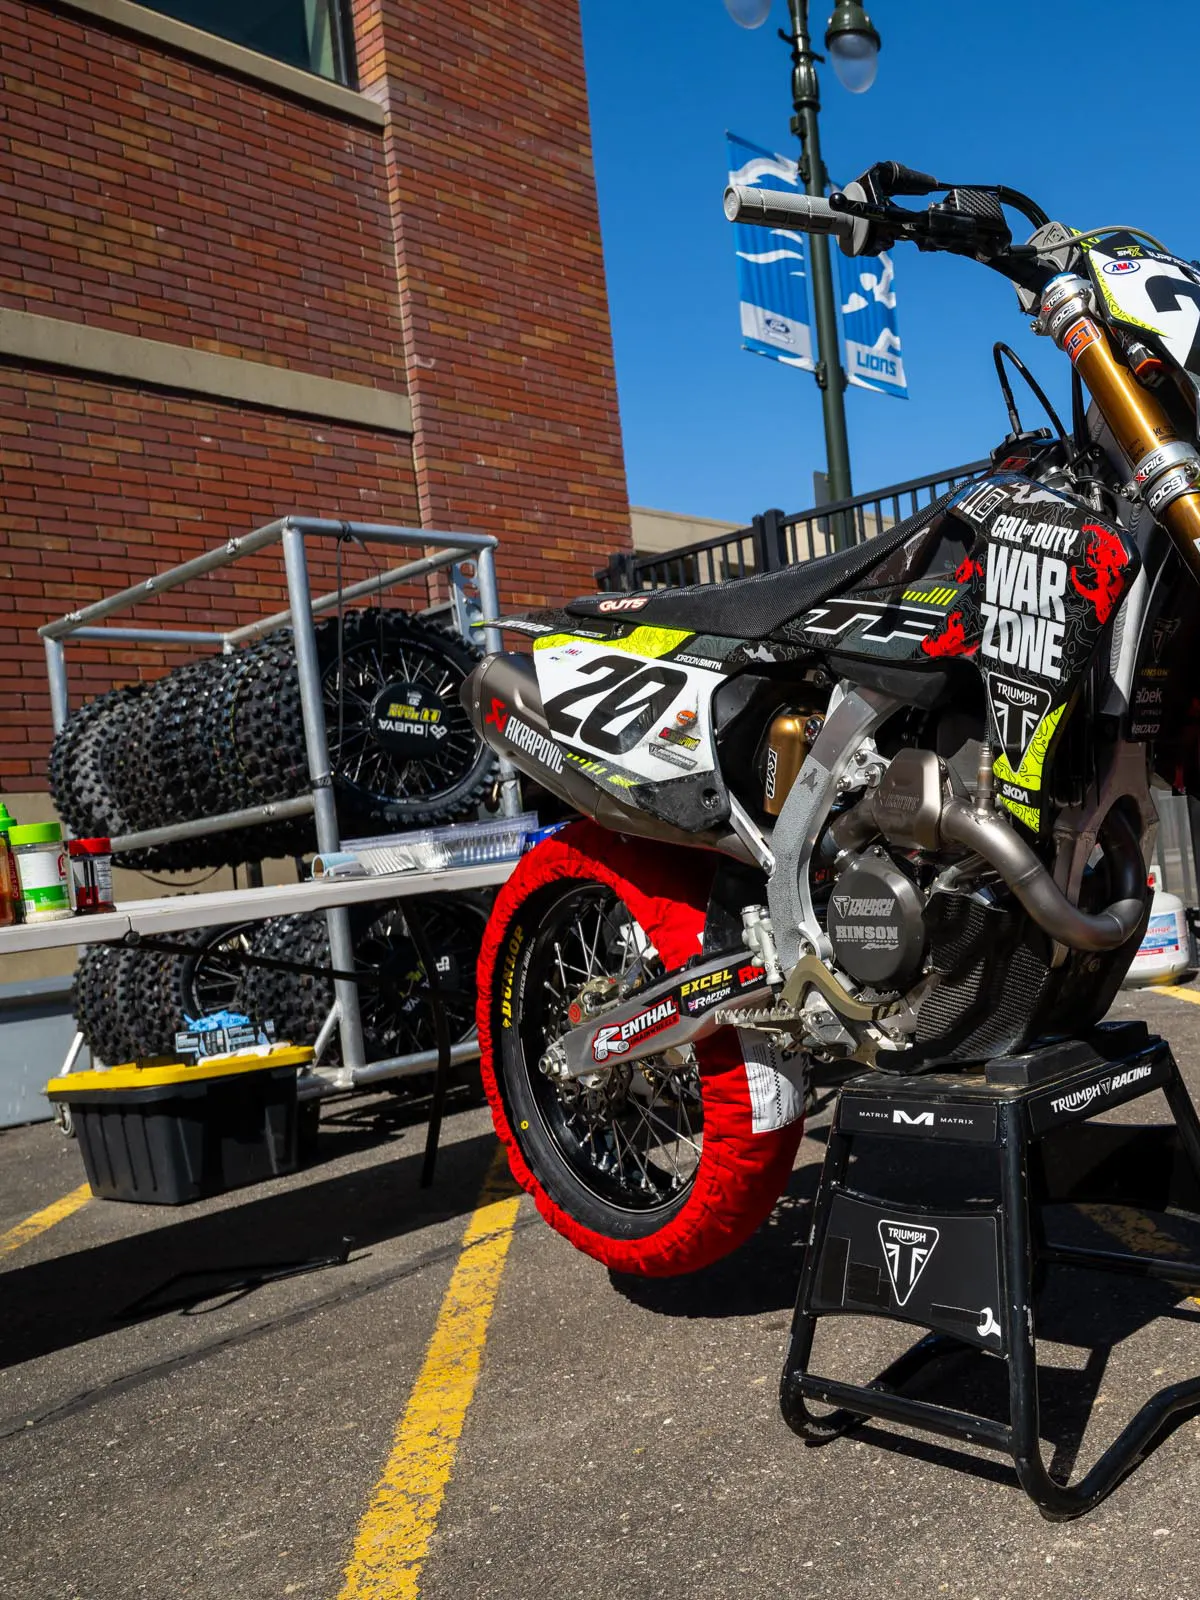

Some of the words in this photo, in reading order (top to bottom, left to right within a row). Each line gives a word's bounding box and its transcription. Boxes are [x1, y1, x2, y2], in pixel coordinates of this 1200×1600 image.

[1112, 262, 1135, 273] AMA
[856, 350, 897, 378] LIONS
[991, 514, 1025, 542] CALL
[1034, 523, 1079, 553] DUTY
[986, 543, 1068, 622] WAR
[599, 598, 648, 612] GUTS
[980, 602, 1063, 680] ZONE
[699, 658, 722, 671] SMITH
[543, 655, 688, 755] 20
[996, 682, 1038, 706] TRIUMPH
[379, 719, 424, 735] DUBYA
[766, 749, 778, 798] KYB
[1002, 783, 1029, 803] SKDA
[835, 925, 899, 940] HINSON
[502, 925, 524, 1018] DUNLOP
[680, 969, 733, 997] EXCEL
[695, 987, 731, 1010] RAPTOR
[594, 1000, 677, 1060] RENTHAL
[1050, 1085, 1101, 1114] TRIUMPH
[1111, 1063, 1152, 1091] RACING
[859, 1111, 889, 1119] MATRIX
[940, 1117, 974, 1126] MATRIX
[888, 1226, 926, 1246] TRIUMPH
